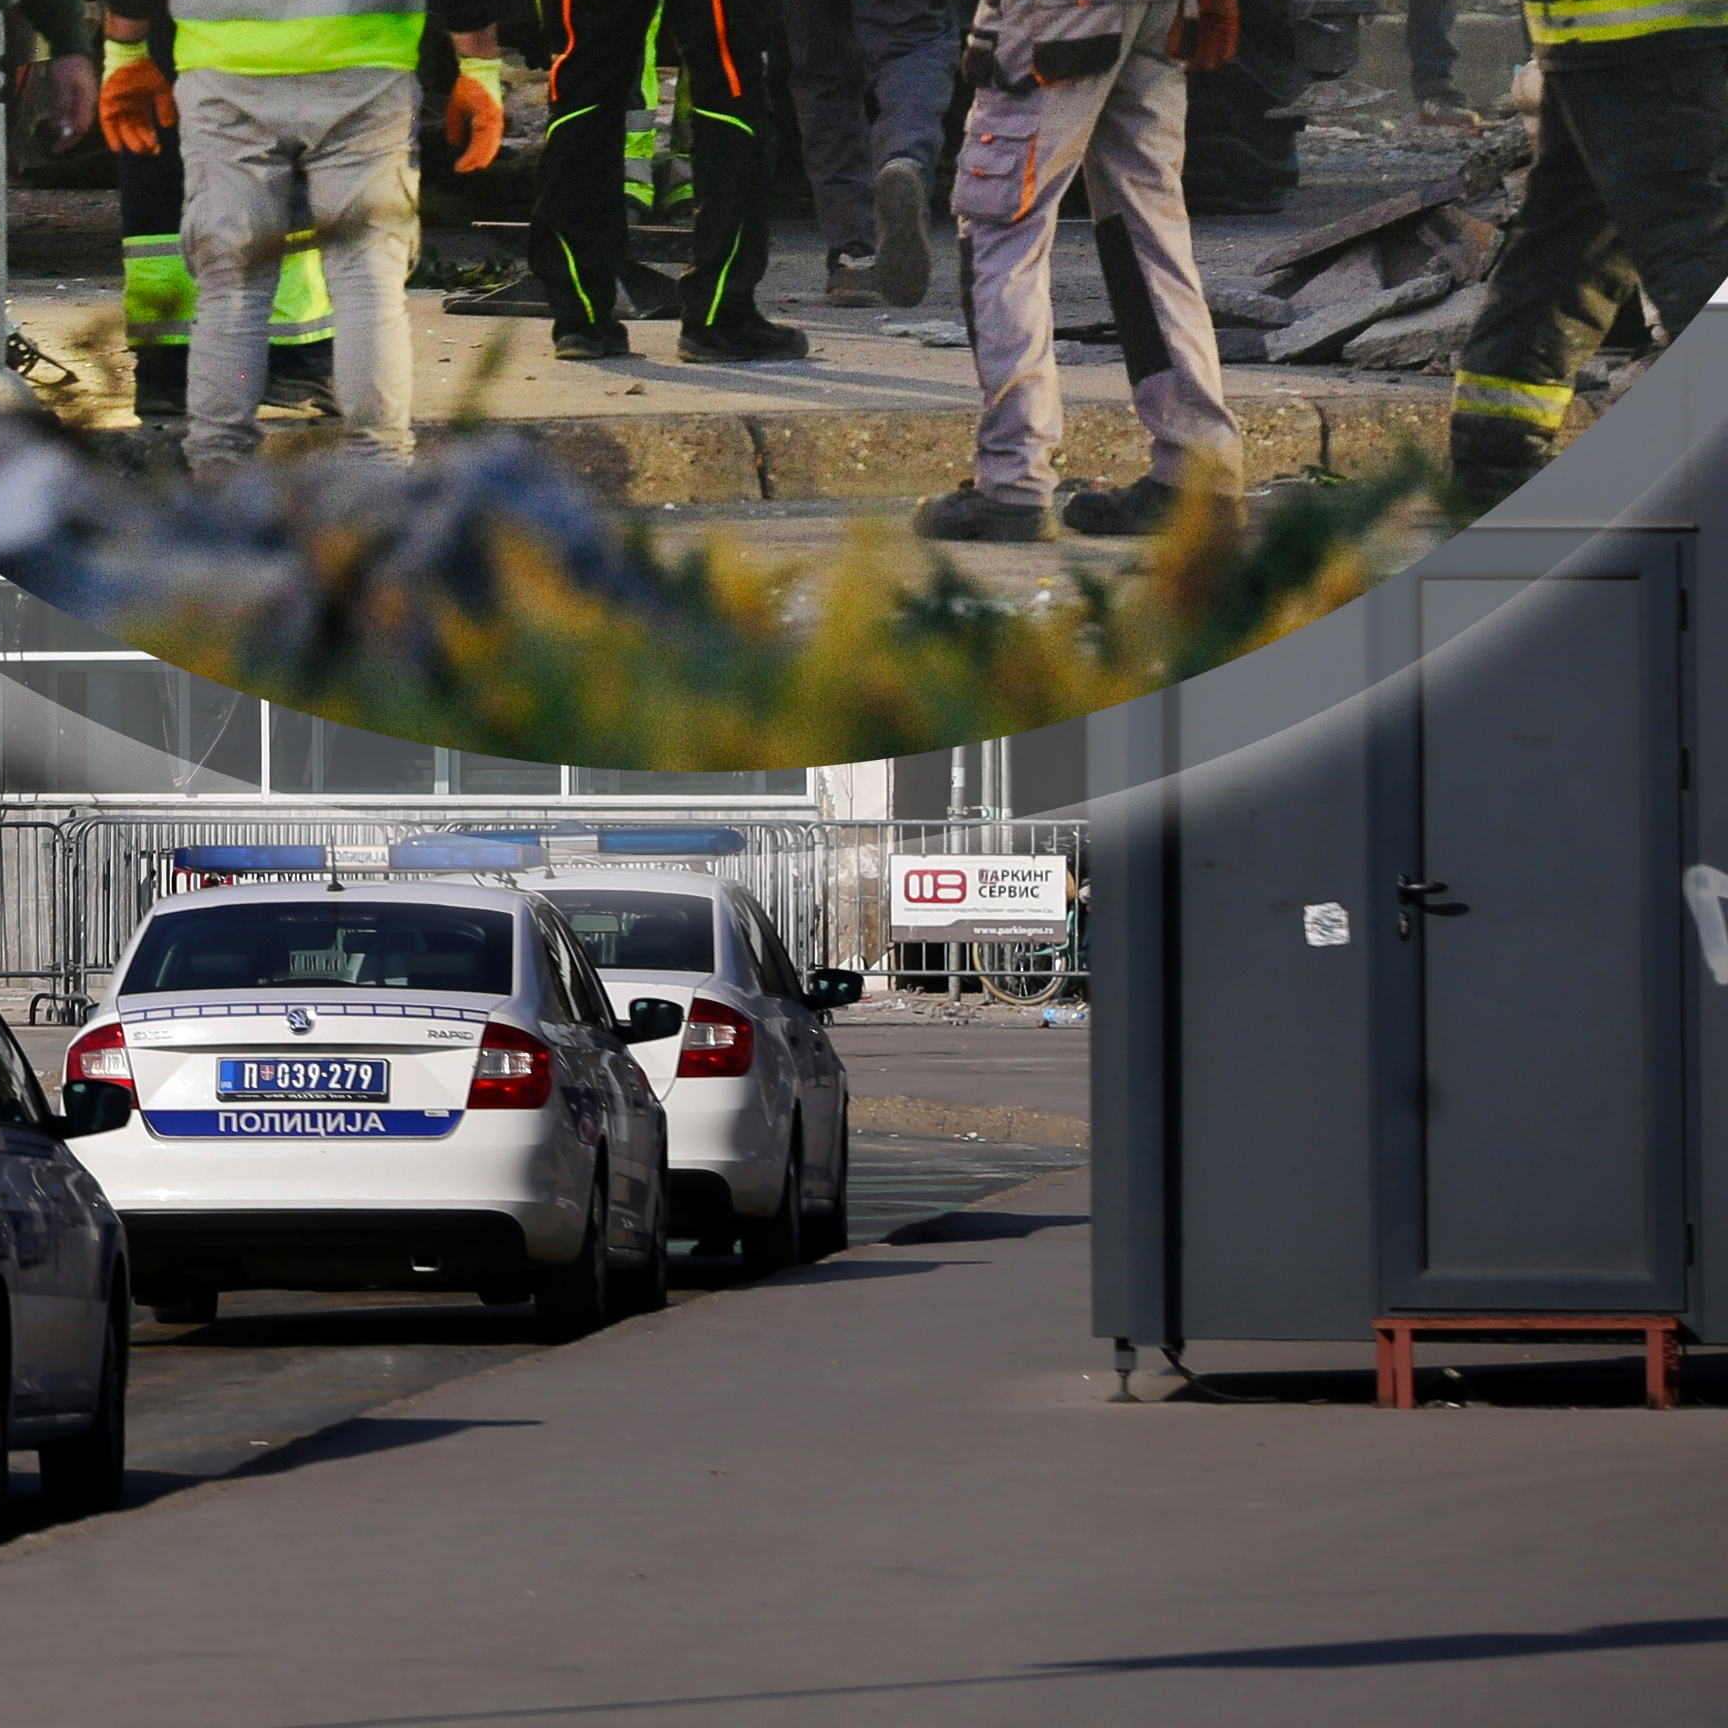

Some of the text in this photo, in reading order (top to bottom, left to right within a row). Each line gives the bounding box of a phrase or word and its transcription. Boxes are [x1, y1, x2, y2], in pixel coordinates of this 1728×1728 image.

[978, 868, 1053, 883] ПАРКИНГ
[978, 884, 1040, 899] СЕРВИС
[426, 1028, 476, 1041] RAPID
[217, 1110, 387, 1138] ПОЛИЦИЈА
